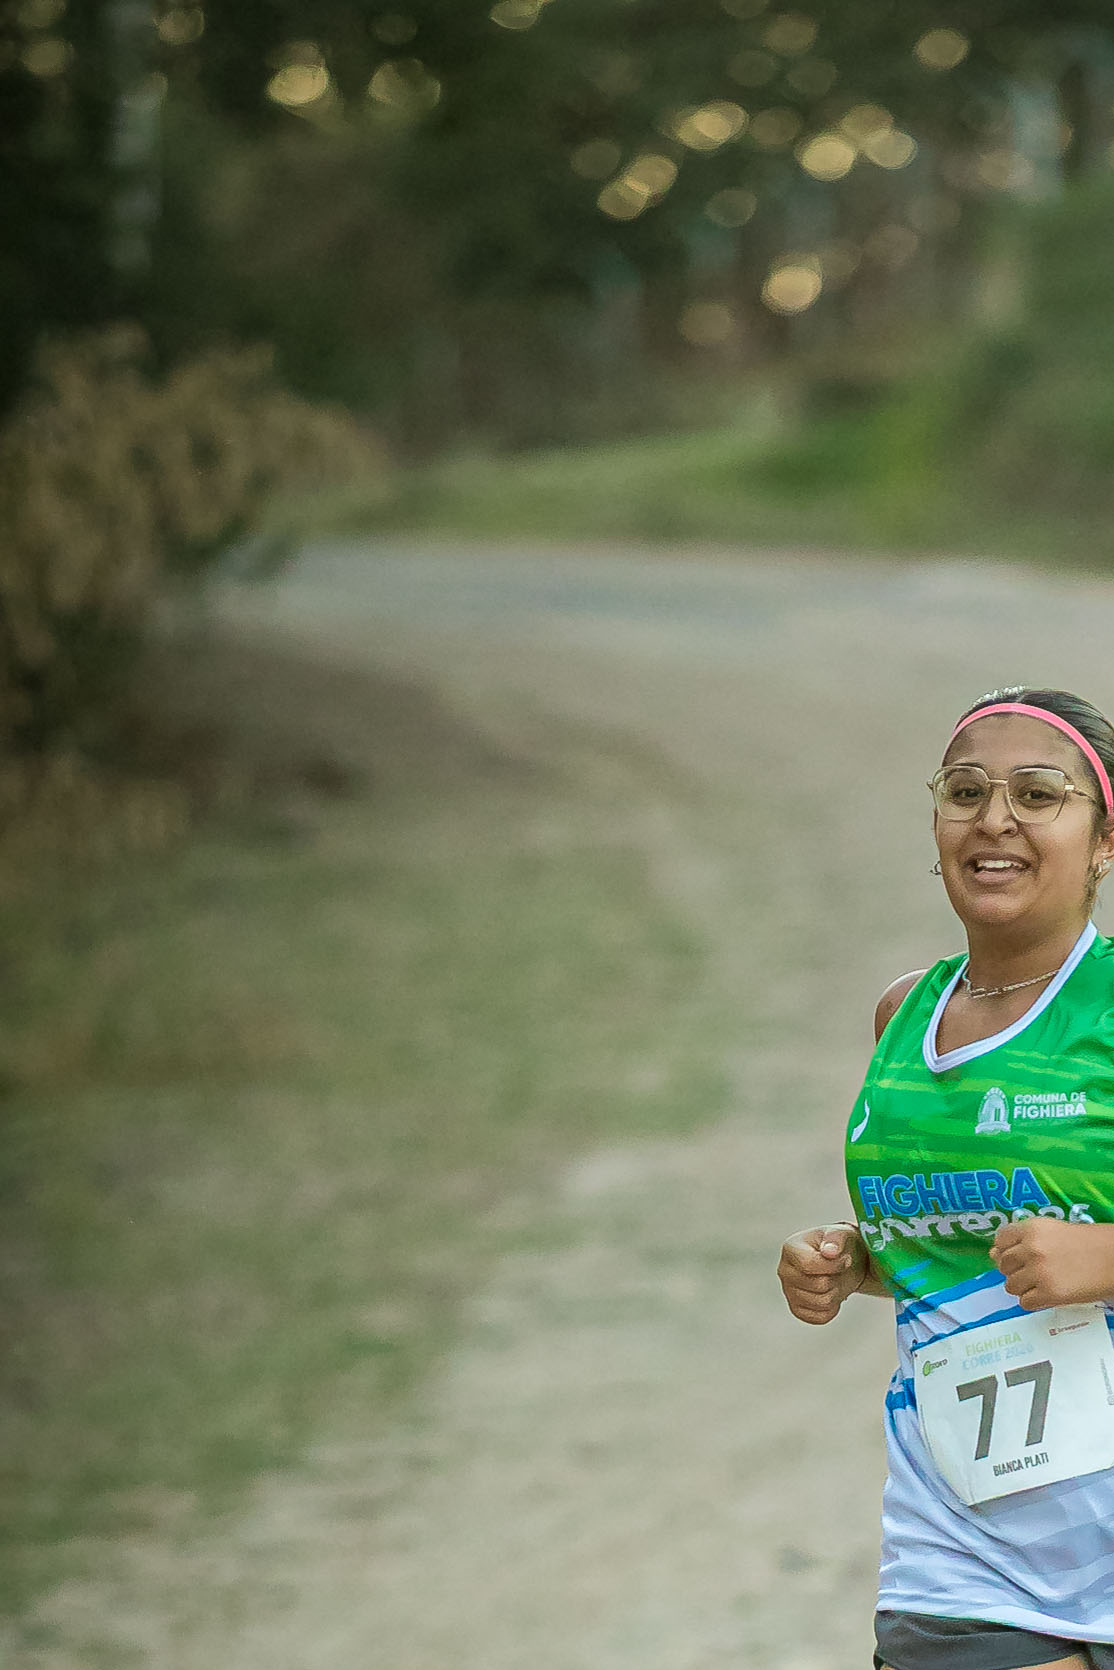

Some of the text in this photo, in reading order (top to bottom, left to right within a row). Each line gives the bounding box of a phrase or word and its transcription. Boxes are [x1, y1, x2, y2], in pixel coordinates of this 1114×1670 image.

[1013, 1091, 1087, 1105] COMUNA DE
[1013, 1103, 1087, 1119] FIGHIERA
[857, 1166, 1051, 1218] FIGHIERA
[965, 1330, 1022, 1356] FIGHIERA
[961, 1350, 1001, 1370] CORRE
[956, 1359, 1054, 1461] 77
[993, 1452, 1049, 1476] BIANCA PLATI
